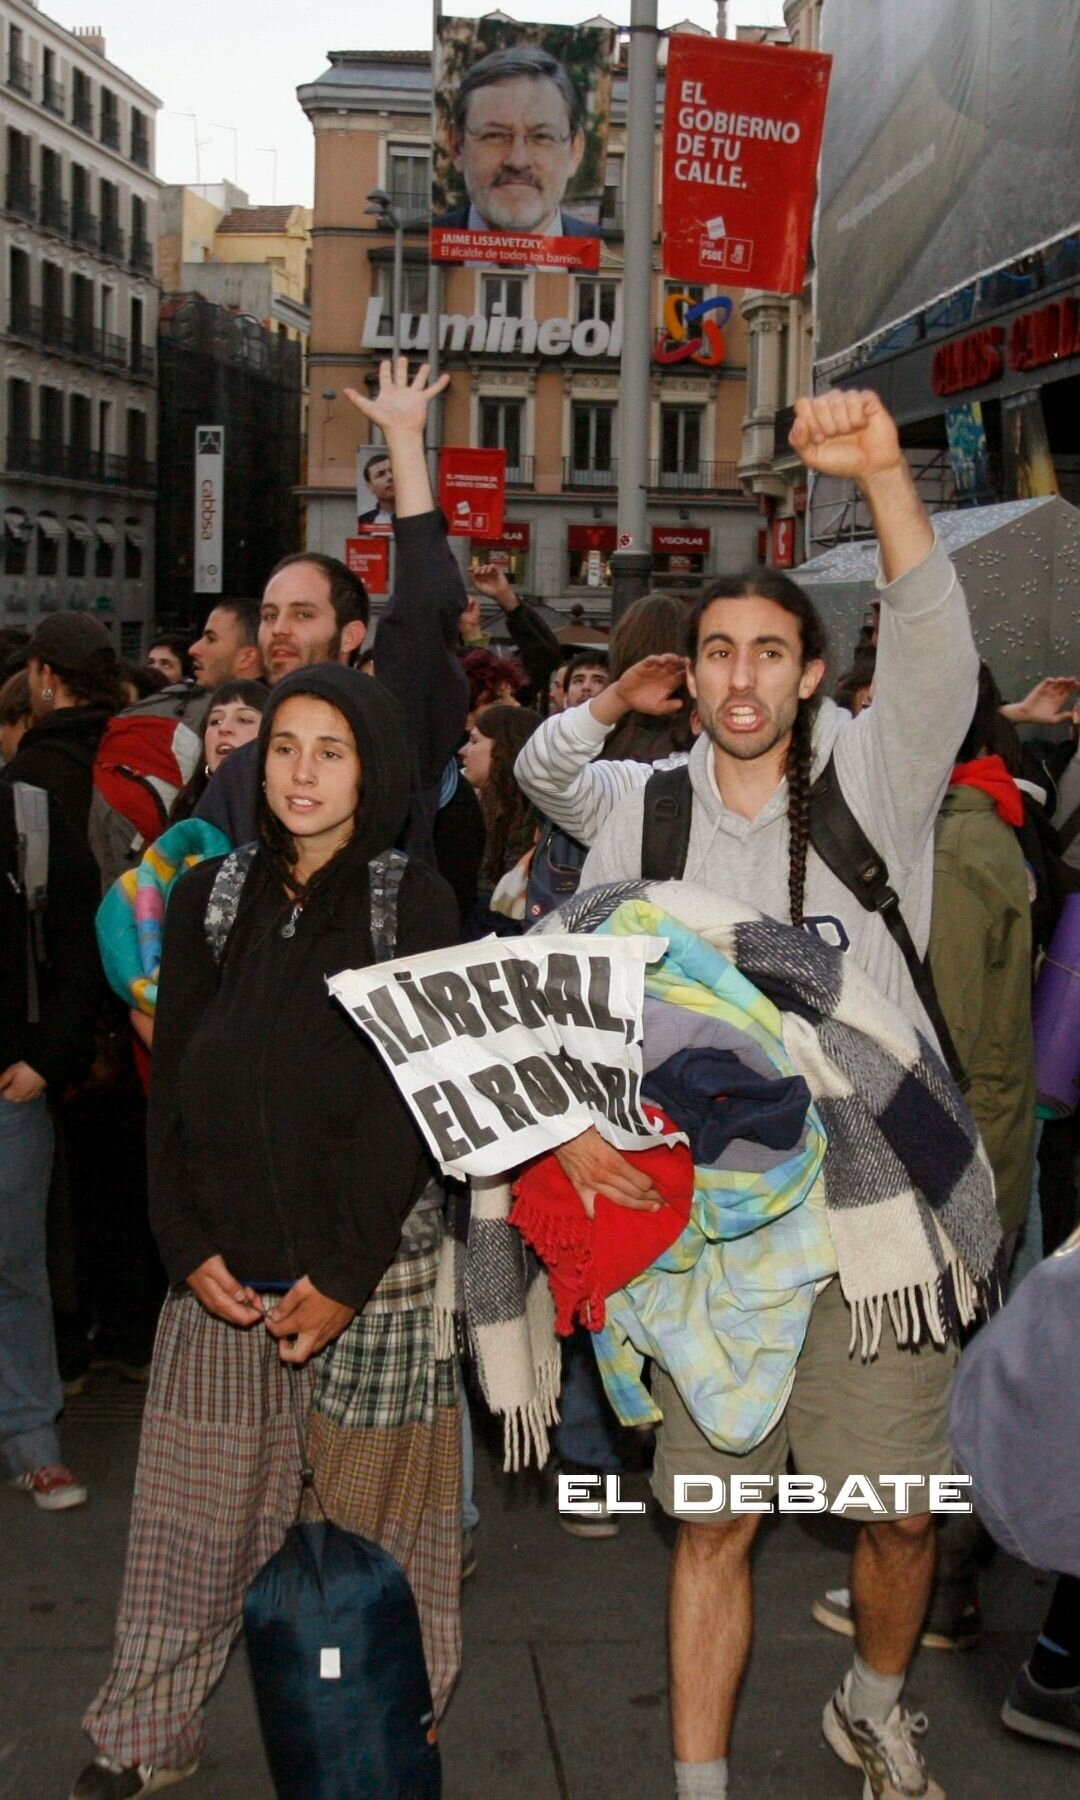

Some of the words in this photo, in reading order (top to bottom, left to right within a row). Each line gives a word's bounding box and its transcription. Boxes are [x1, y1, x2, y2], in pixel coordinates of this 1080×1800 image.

[681, 81, 707, 105] EL
[678, 108, 801, 144] GOBIERNO
[676, 133, 706, 157] DE
[711, 137, 741, 161] TU
[675, 159, 747, 189] CALLE.
[441, 233, 471, 245] JAIME
[472, 235, 545, 249] LISSAVETZKY.
[441, 246, 449, 256] El
[451, 246, 483, 258] alcalde
[485, 248, 497, 258] de
[499, 249, 528, 260] todos
[530, 251, 545, 262] los
[546, 253, 583, 265] barrios.
[201, 479, 216, 541] cabbsa
[659, 536, 704, 546] VISIONLAB
[411, 1079, 500, 1162] EL
